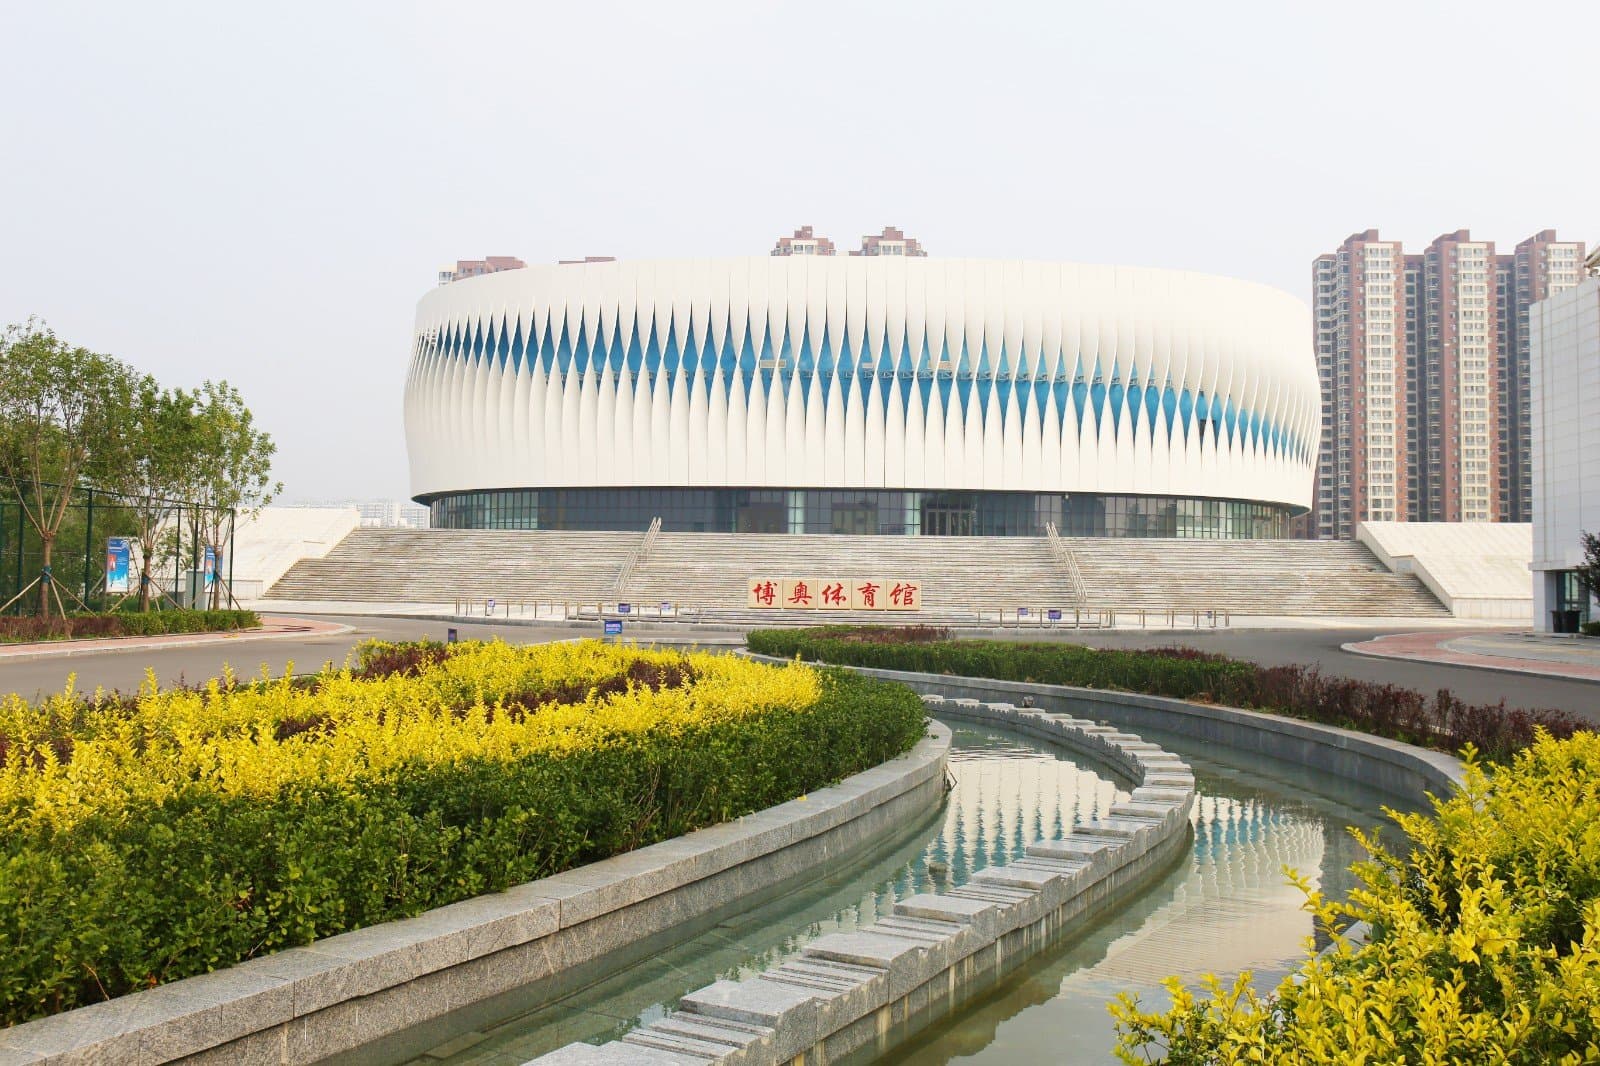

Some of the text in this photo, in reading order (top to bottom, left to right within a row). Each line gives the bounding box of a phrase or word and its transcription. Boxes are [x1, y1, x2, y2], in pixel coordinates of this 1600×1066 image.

[752, 581, 918, 608] 博奥体育馆
